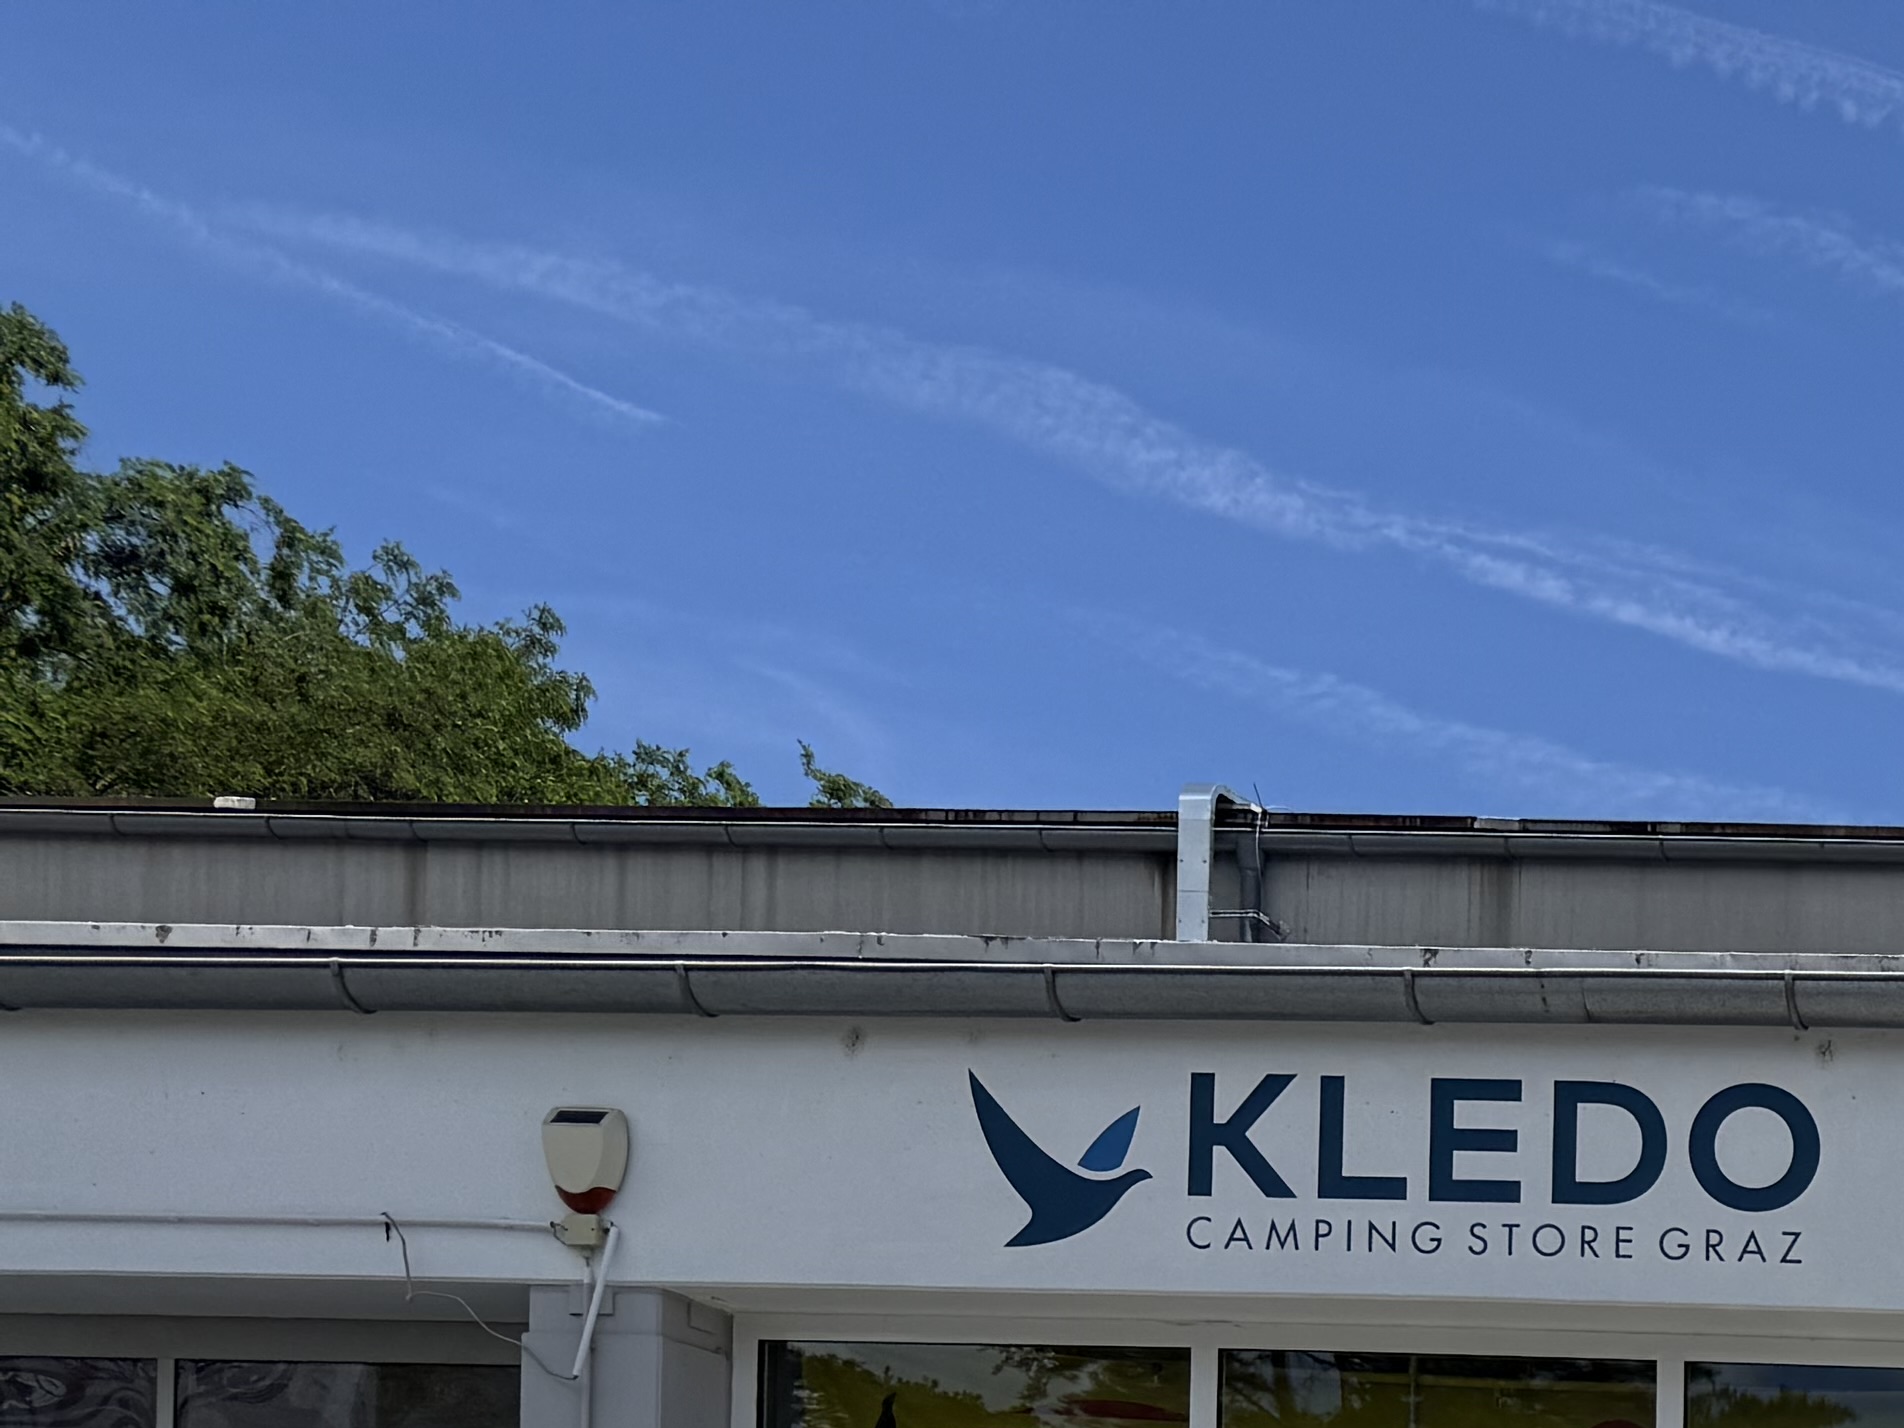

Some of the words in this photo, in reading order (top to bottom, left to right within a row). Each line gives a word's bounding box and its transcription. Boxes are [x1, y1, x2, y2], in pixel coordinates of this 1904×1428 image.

[1187, 1071, 1821, 1212] KLEDO
[1186, 1216, 1443, 1255] CAMPING
[1467, 1222, 1634, 1259] STORE
[1658, 1227, 1803, 1265] GRAZ
